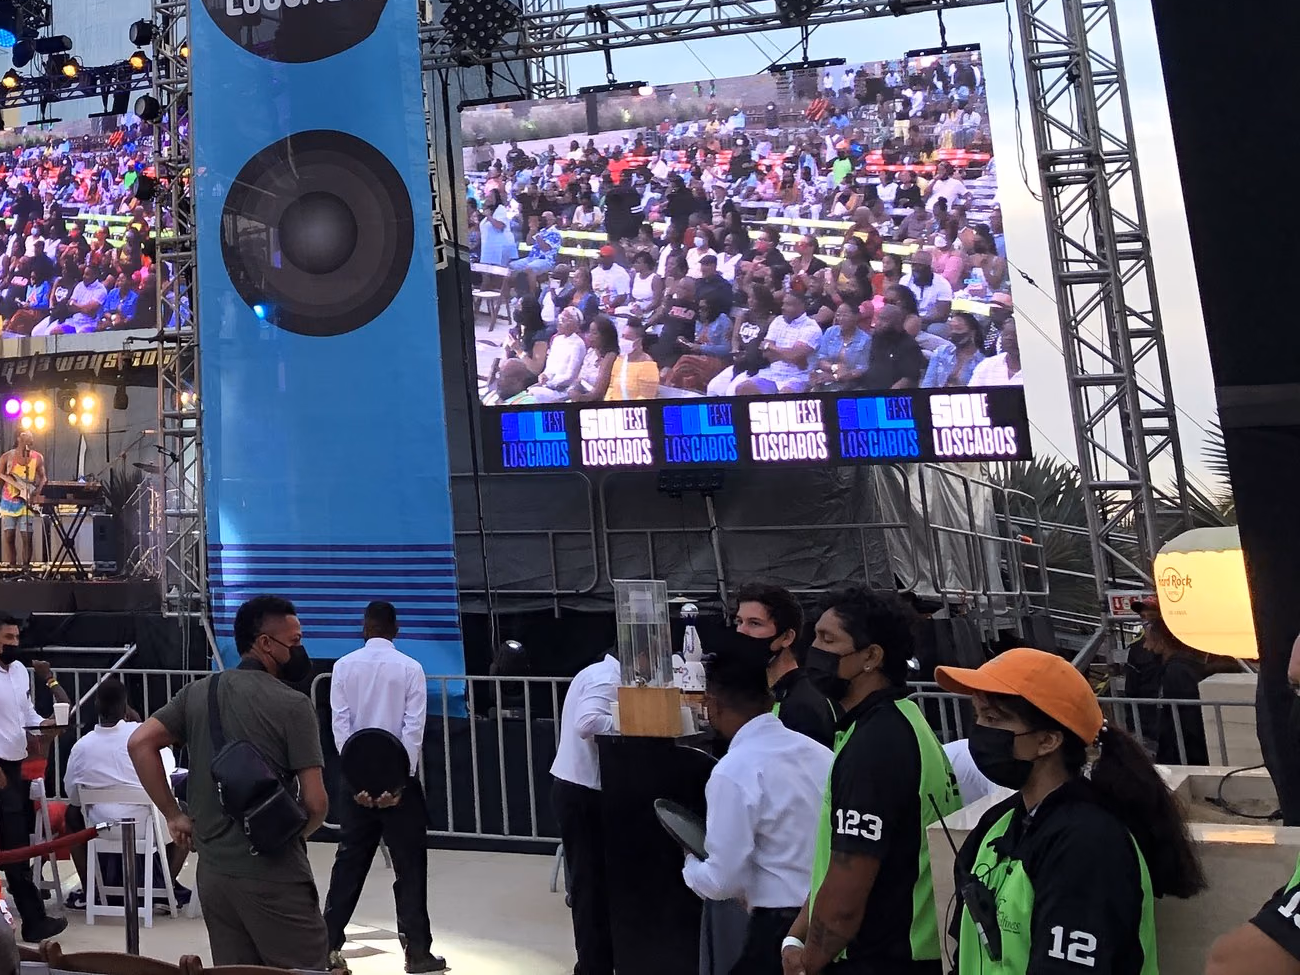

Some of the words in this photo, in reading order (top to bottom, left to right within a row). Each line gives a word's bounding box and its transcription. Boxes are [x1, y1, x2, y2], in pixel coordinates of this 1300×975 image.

[542, 410, 566, 433] FEST
[709, 403, 733, 425] FEST
[748, 400, 824, 434] SOL
[795, 399, 822, 424] FEST
[886, 396, 913, 419] FEST
[579, 407, 649, 440] SOL
[623, 406, 648, 430] FEST
[502, 441, 570, 468] LOSCABOS
[581, 439, 653, 467] LOSCABOS
[664, 435, 738, 463] LOSCABOS
[751, 432, 828, 462] LOSCABOS
[838, 429, 920, 459] LOSCABOS
[931, 426, 1018, 457] LOSCABOS
[1171, 574, 1193, 589] Rock
[836, 808, 883, 841] 123
[1048, 925, 1097, 967] 12
